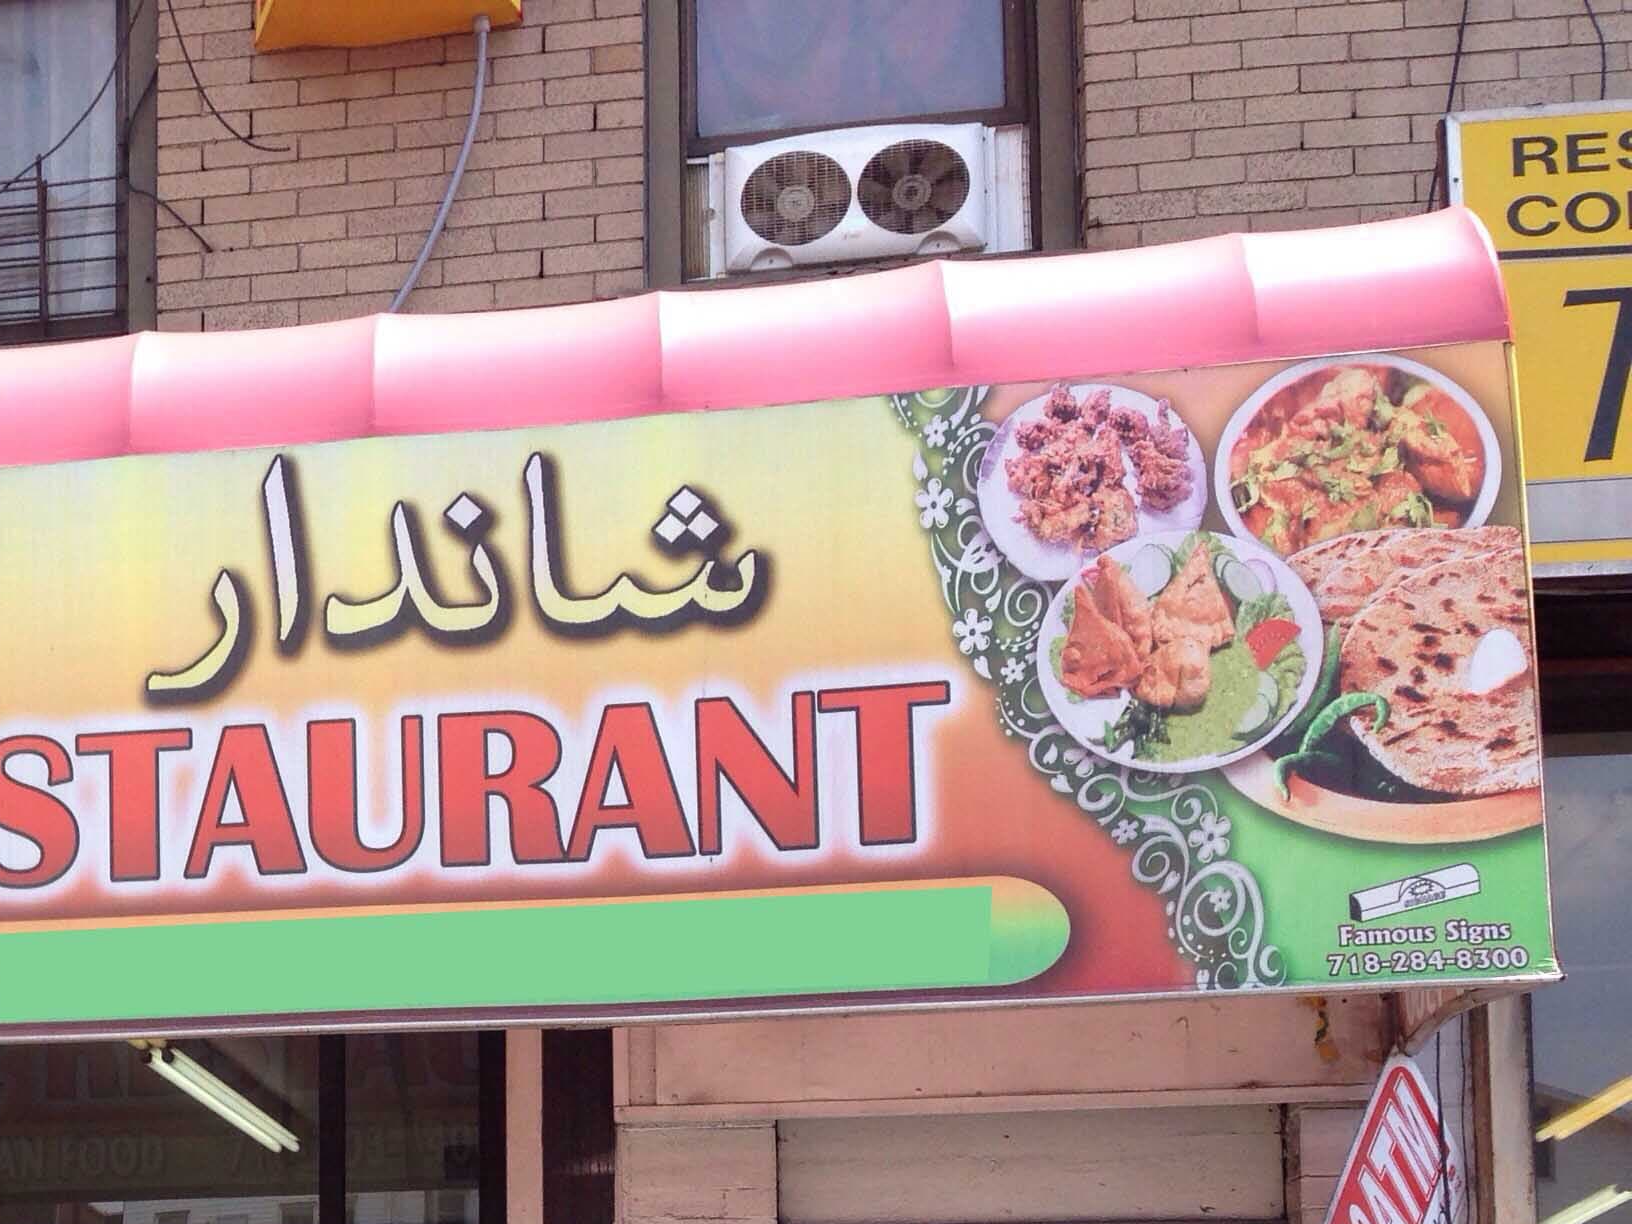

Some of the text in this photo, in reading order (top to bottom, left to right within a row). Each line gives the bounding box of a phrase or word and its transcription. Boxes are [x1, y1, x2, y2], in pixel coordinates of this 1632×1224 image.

[1506, 190, 1632, 237] CO
[145, 452, 763, 697] شاندار
[1338, 919, 1512, 947] Famous Signs
[1326, 947, 1529, 976] 718-284-8300
